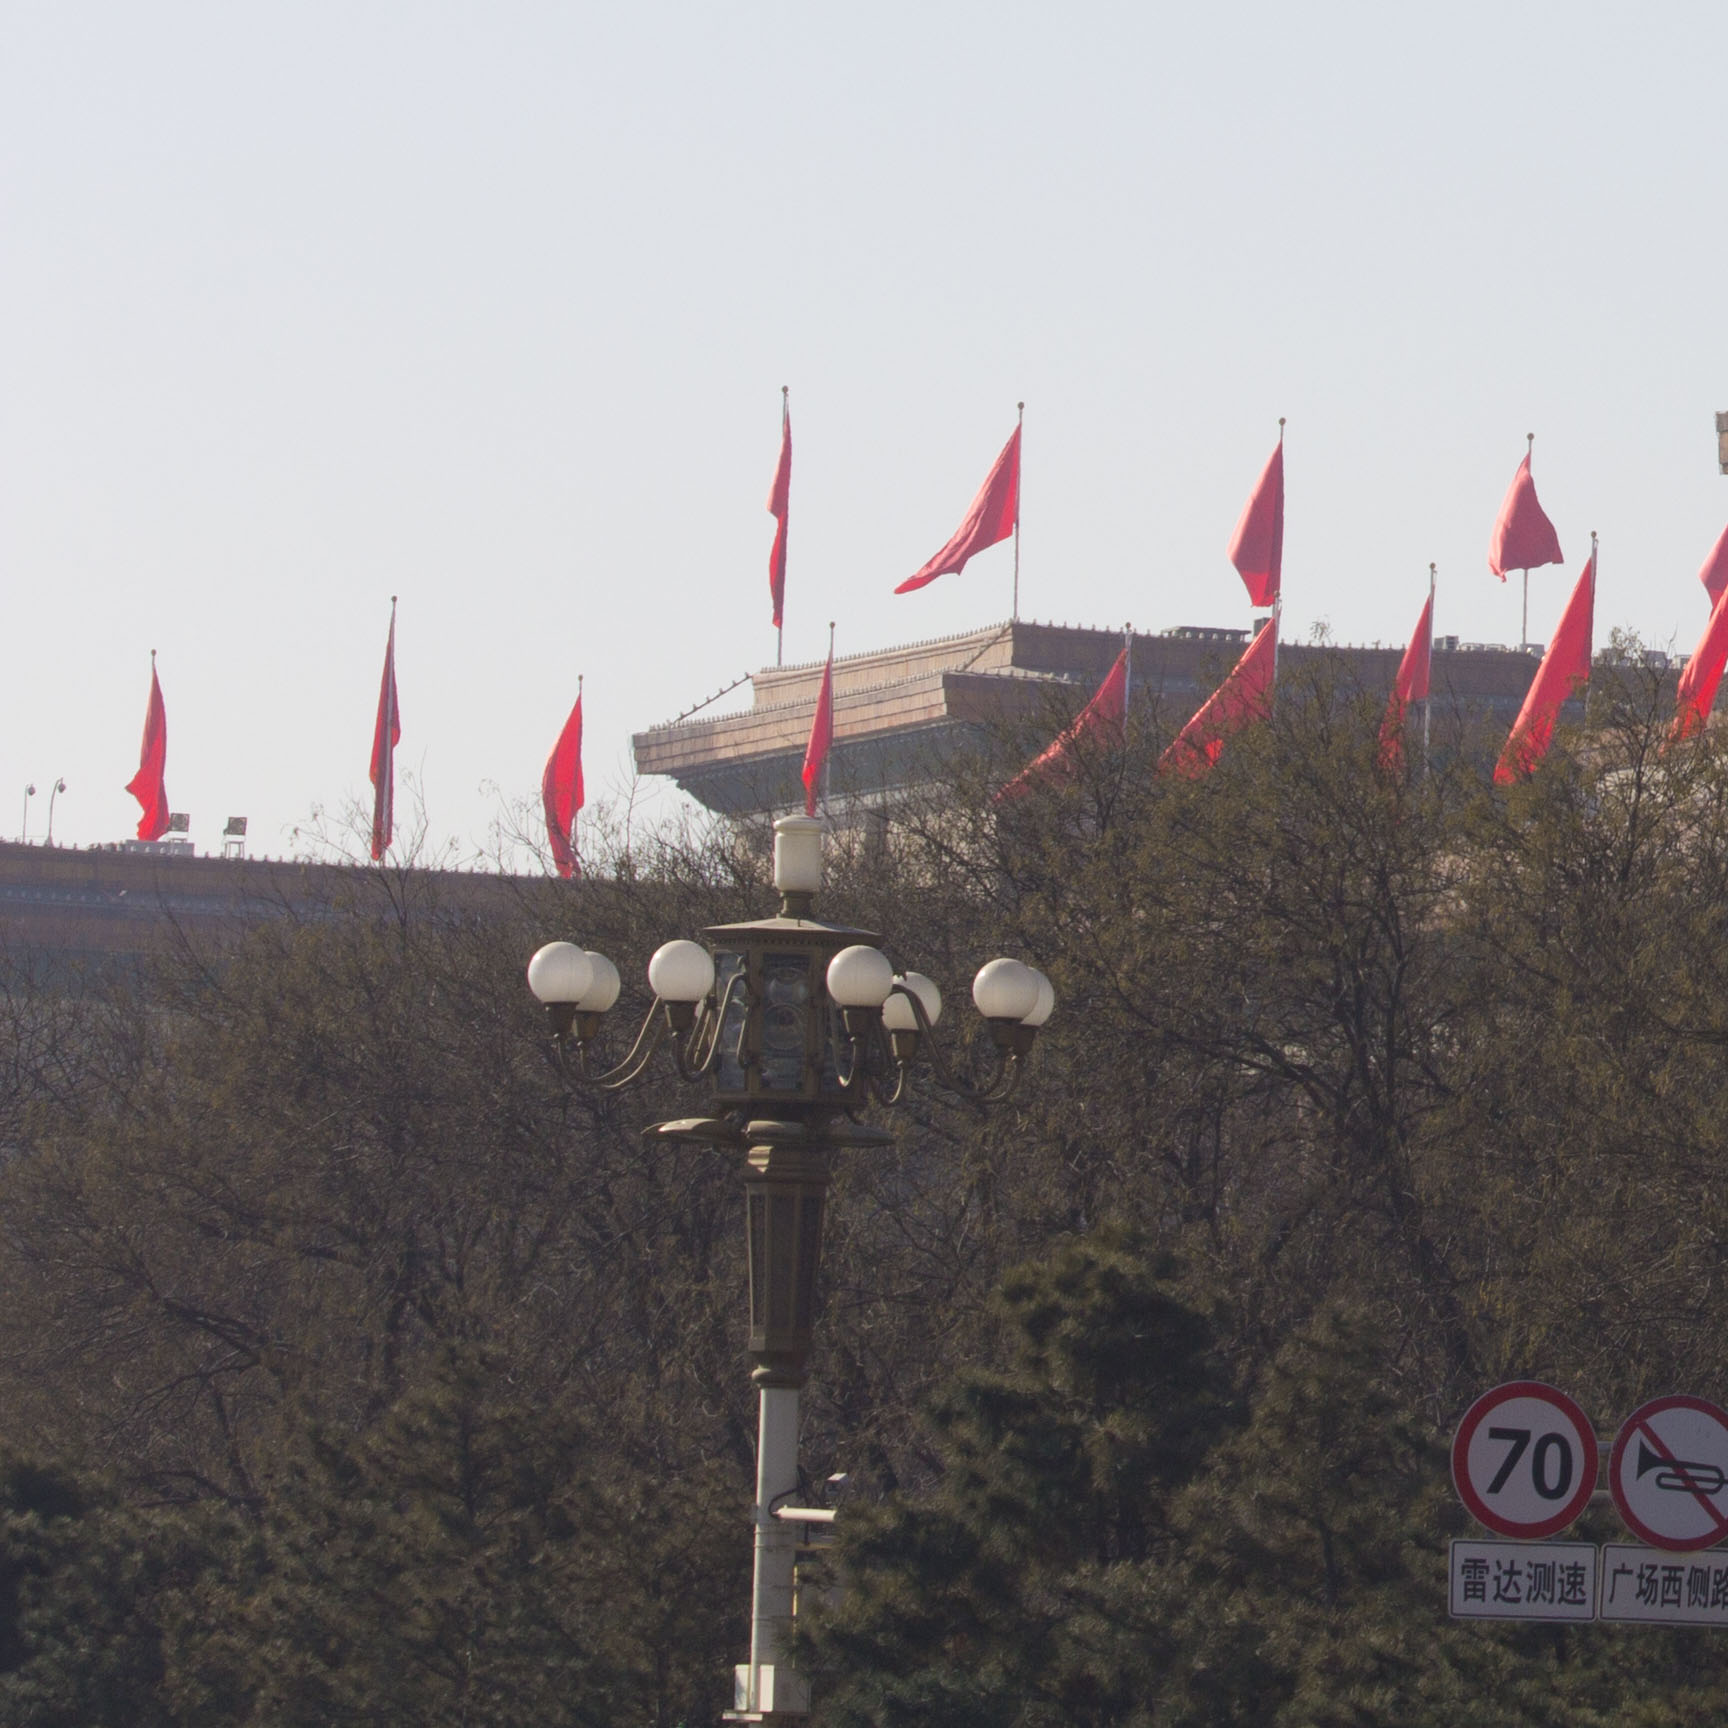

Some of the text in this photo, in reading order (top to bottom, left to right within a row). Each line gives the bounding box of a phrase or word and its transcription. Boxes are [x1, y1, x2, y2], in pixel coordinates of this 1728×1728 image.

[1486, 1427, 1573, 1501] 70
[1461, 1558, 1587, 1606] 雷达测速
